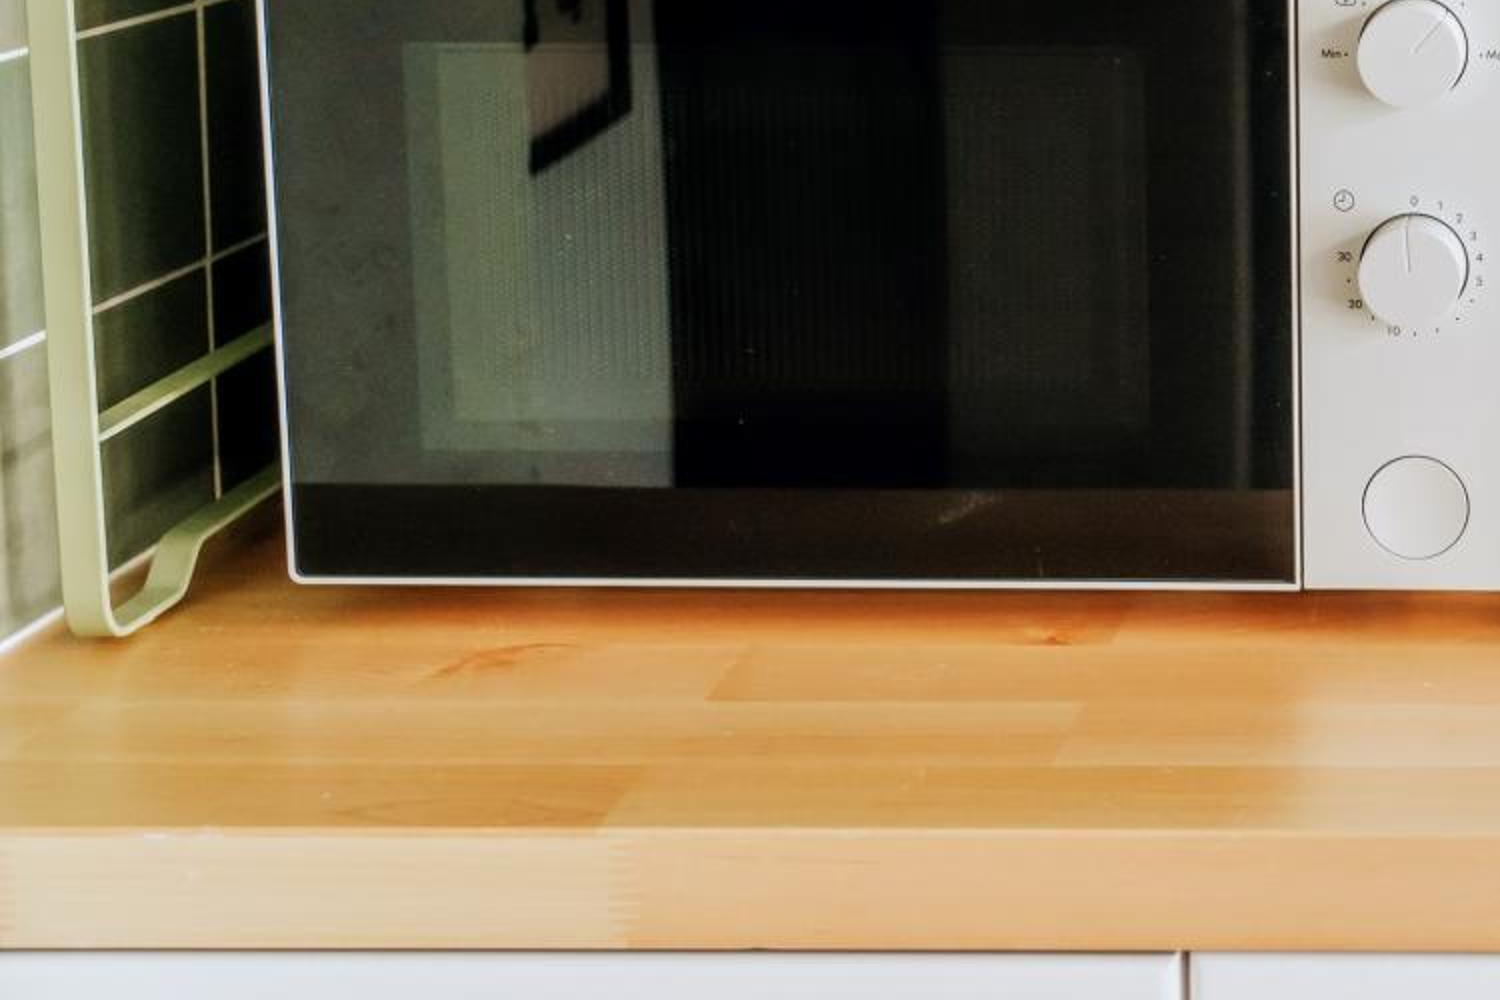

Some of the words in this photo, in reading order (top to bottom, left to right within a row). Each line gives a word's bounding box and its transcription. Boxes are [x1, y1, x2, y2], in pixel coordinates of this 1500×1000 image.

[1321, 48, 1342, 58] Min
[1409, 195, 1419, 207] 0
[1456, 213, 1464, 224] 2
[1337, 251, 1352, 263] 30
[1475, 253, 1484, 262] 4
[1387, 326, 1401, 337] 10
